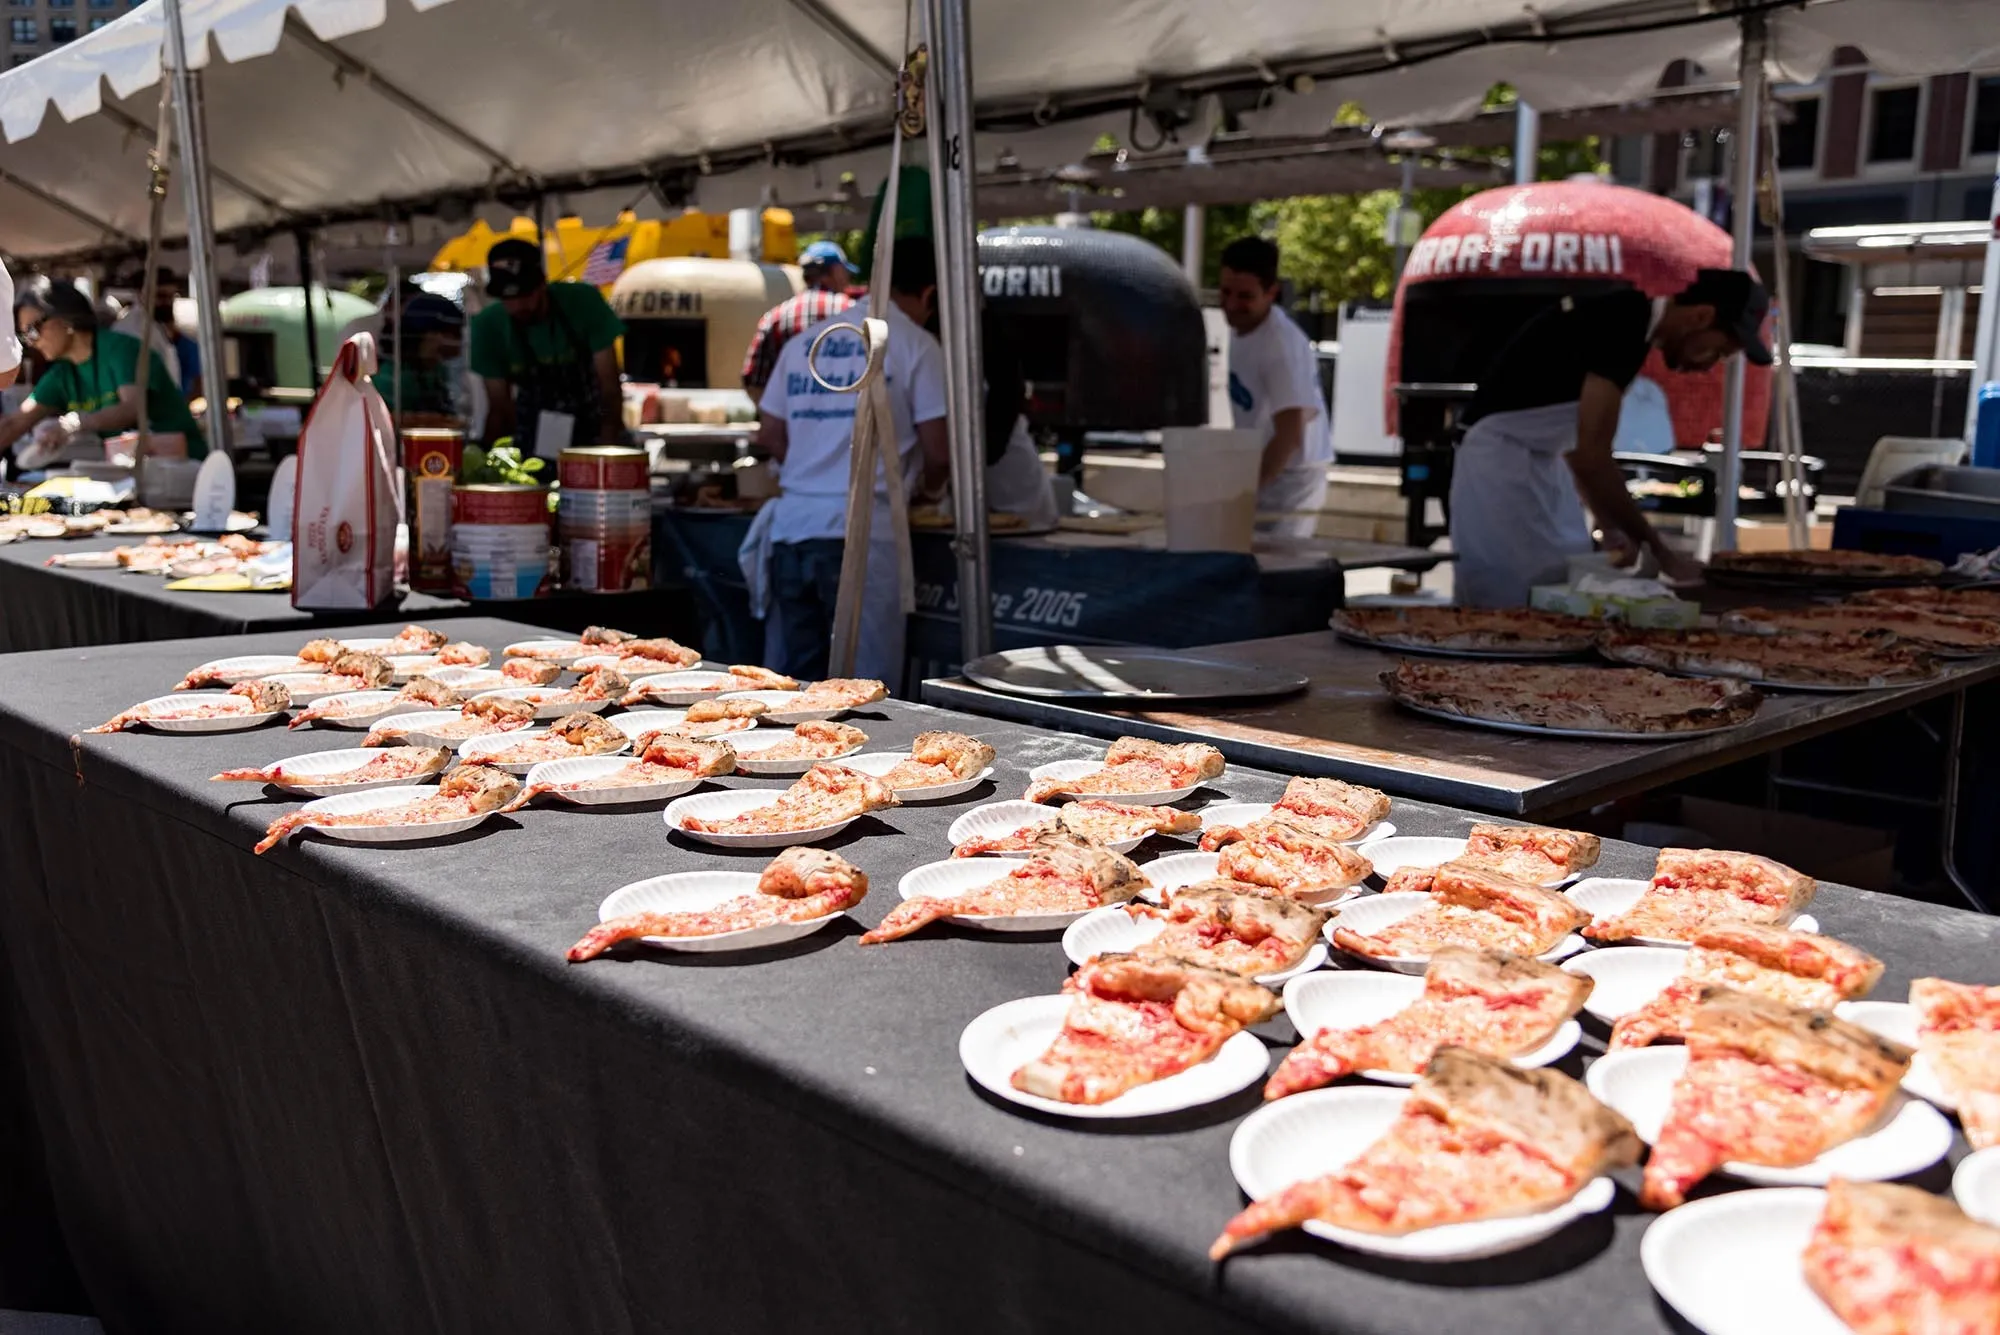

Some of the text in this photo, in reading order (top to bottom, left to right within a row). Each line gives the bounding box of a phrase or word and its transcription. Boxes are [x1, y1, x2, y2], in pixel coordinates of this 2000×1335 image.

[1487, 232, 1623, 274] FORNI
[978, 265, 1062, 297] ORNI
[1012, 587, 1088, 627] 2005
